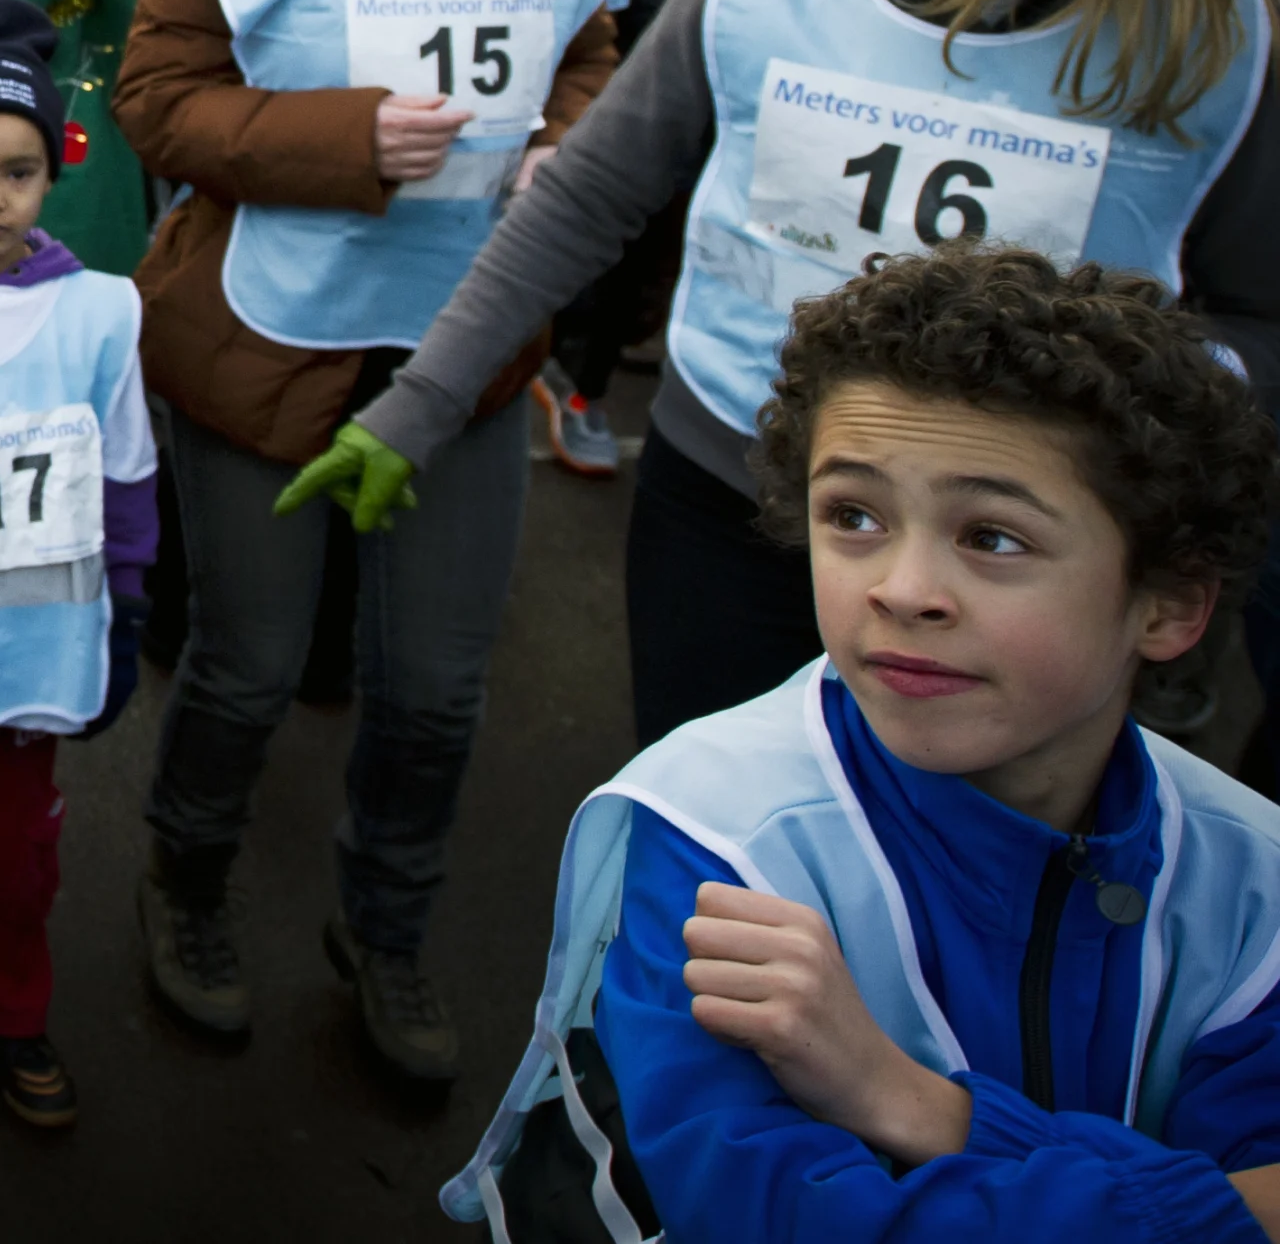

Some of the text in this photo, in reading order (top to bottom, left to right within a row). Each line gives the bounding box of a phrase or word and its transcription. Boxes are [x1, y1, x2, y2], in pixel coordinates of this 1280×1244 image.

[419, 25, 512, 96] 15
[773, 78, 881, 125] Meters
[891, 110, 960, 139] voor
[968, 127, 1100, 169] mama's
[842, 142, 995, 246] 16
